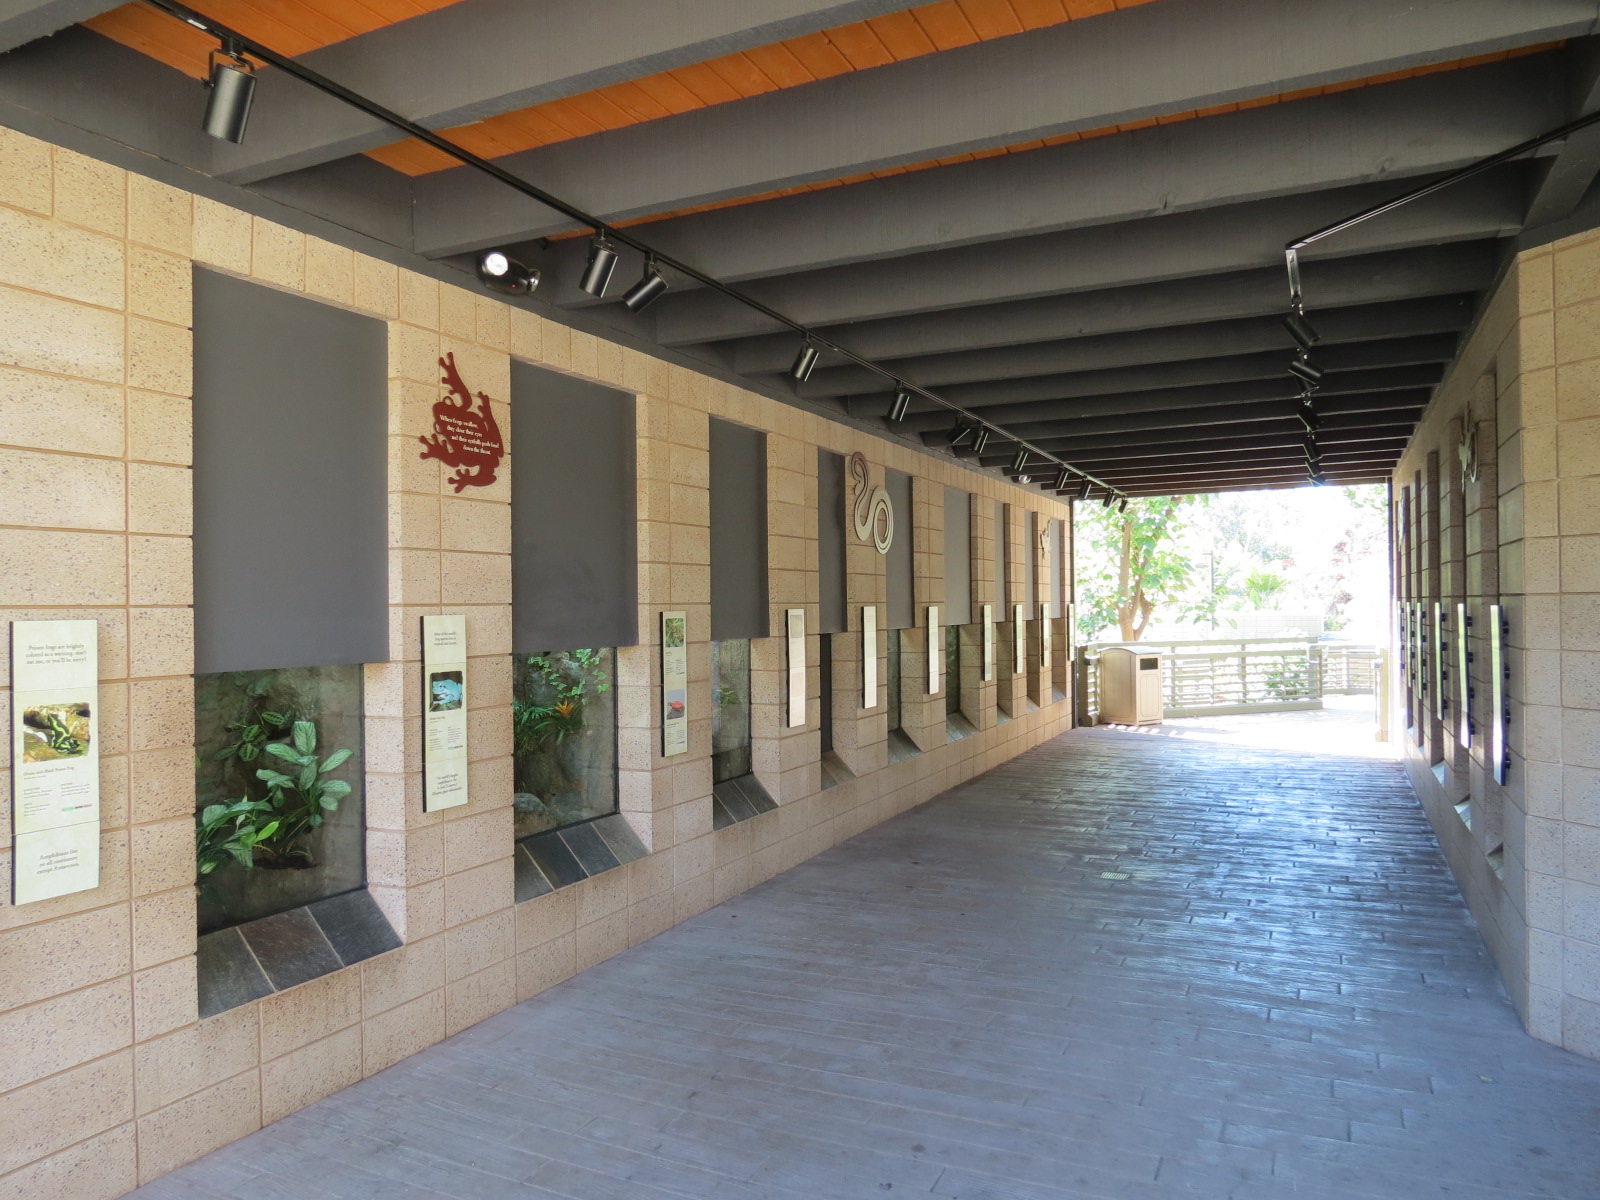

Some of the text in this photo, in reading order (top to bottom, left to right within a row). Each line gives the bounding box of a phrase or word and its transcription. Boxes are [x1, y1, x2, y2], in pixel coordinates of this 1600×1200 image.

[440, 414, 452, 423] When
[452, 418, 463, 426] frogs
[446, 424, 455, 432] they
[66, 643, 84, 651] brightly
[54, 856, 78, 864] continents
